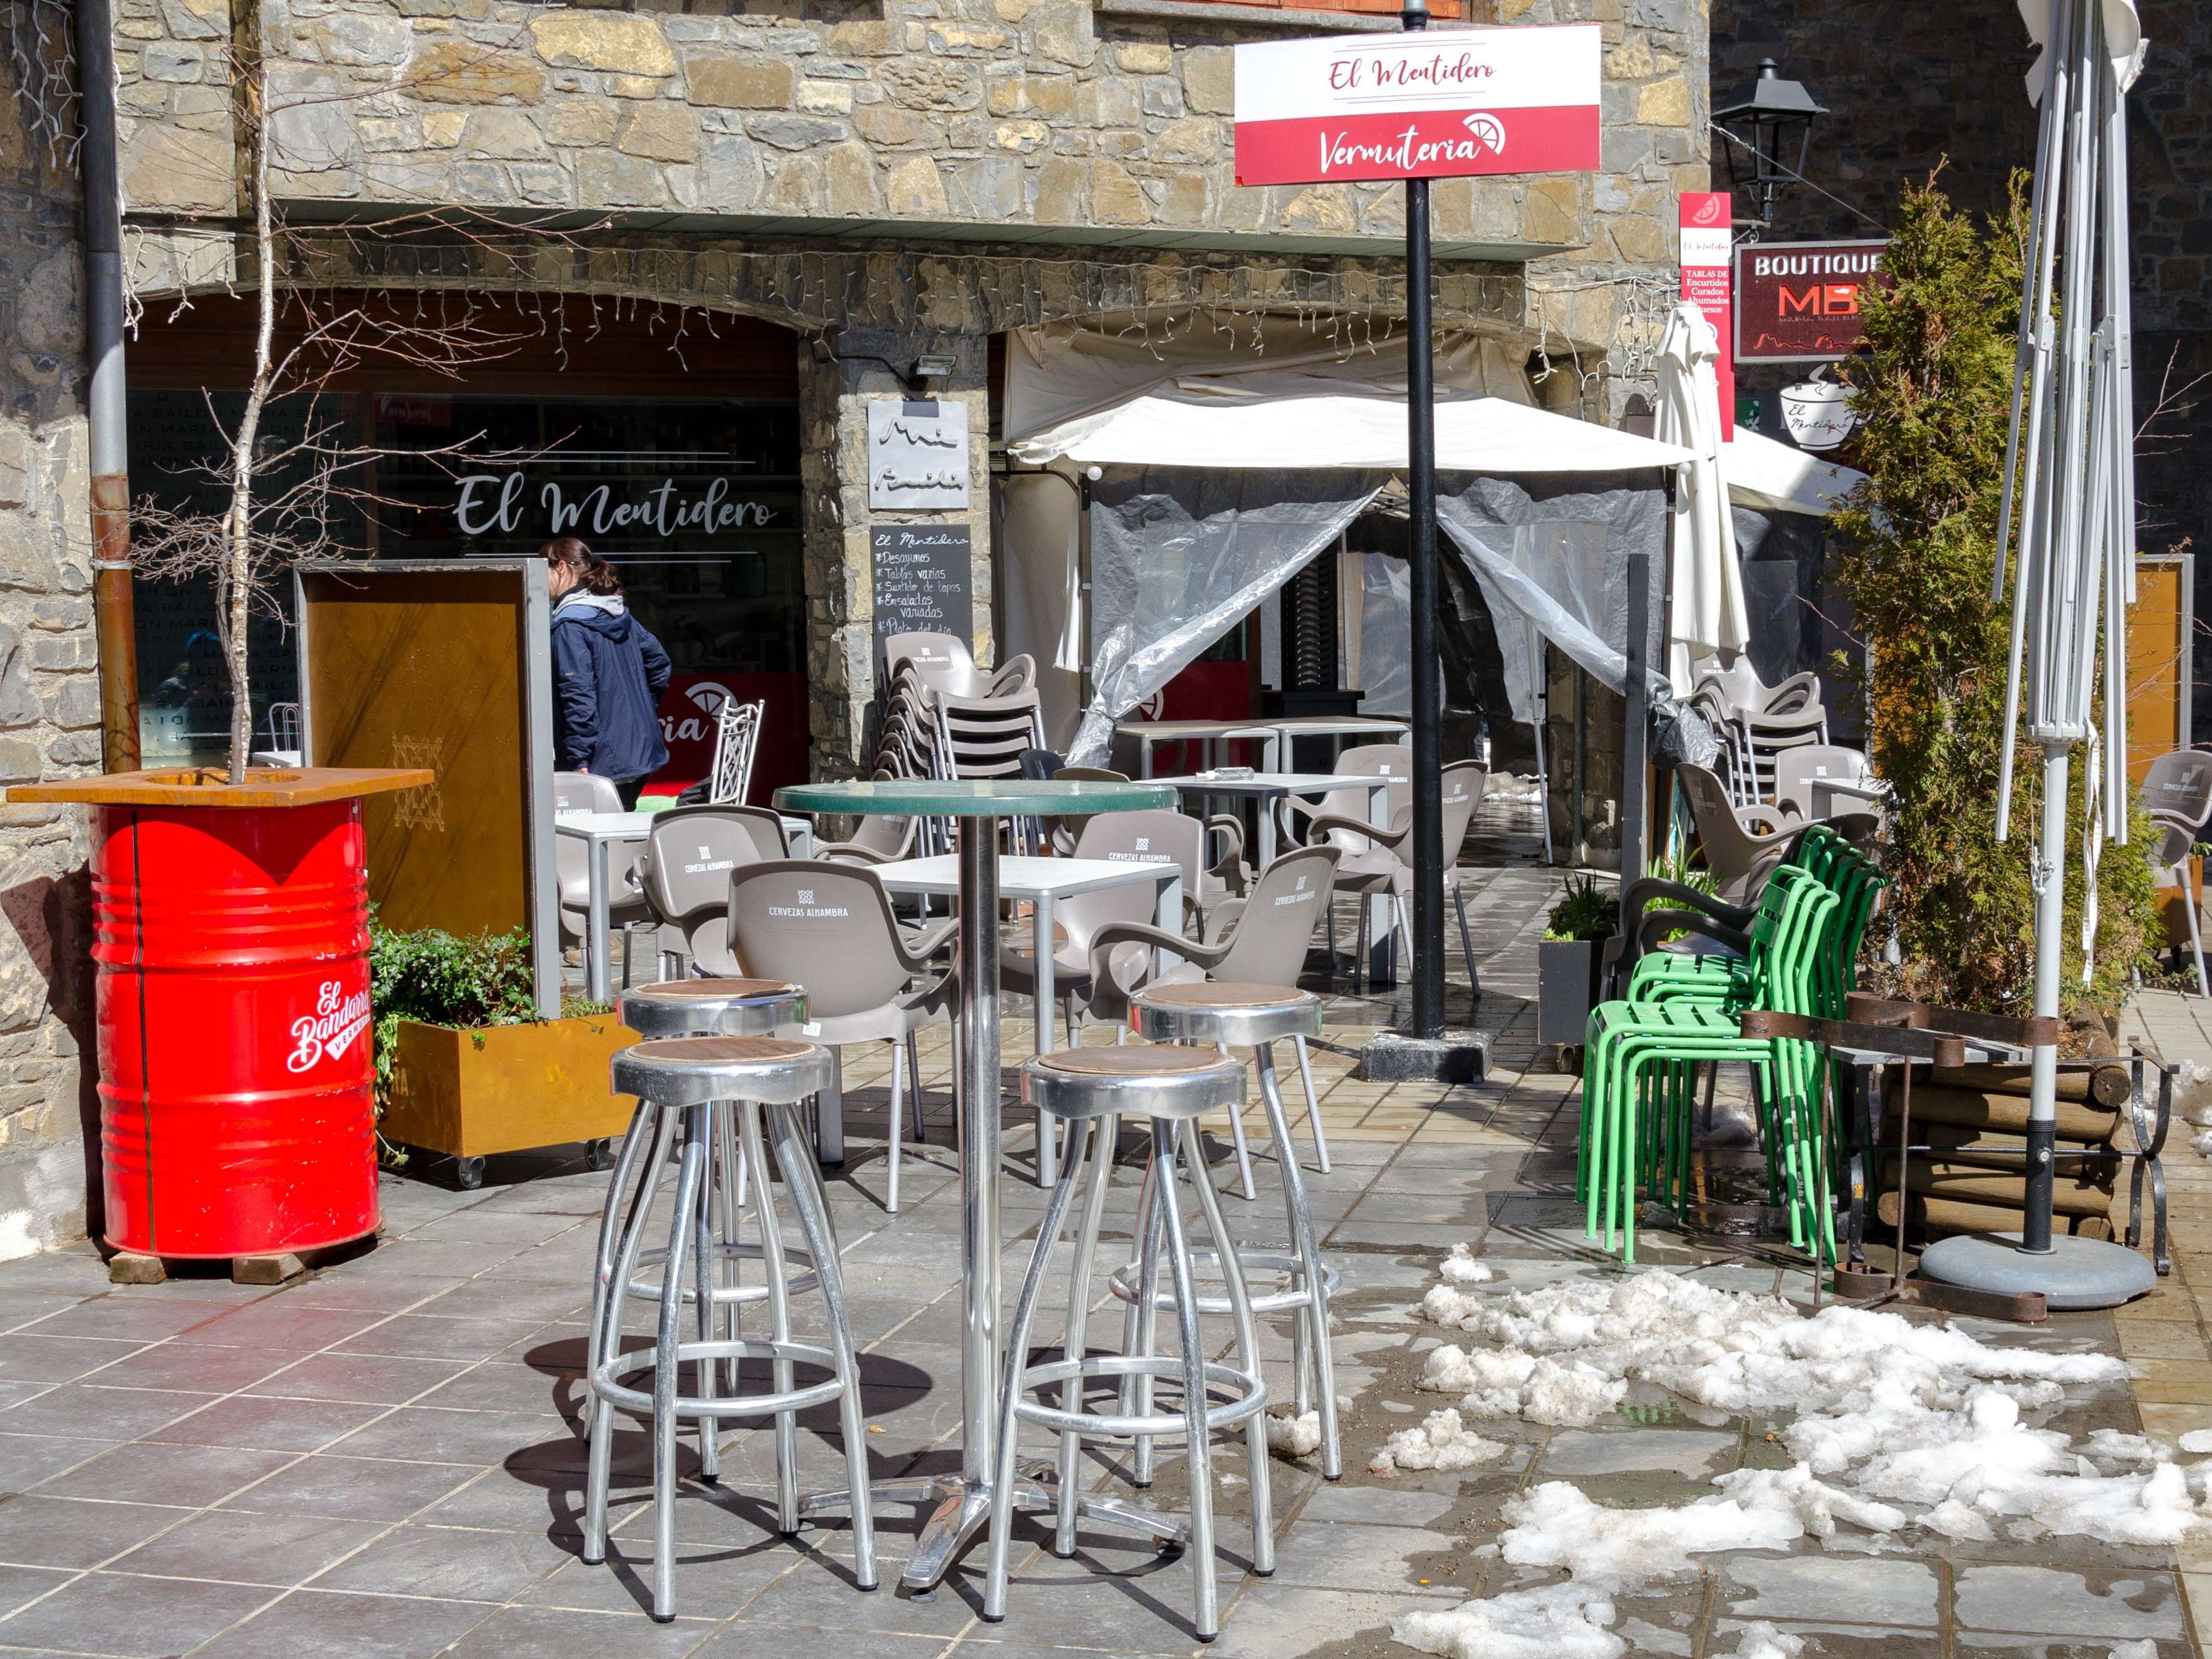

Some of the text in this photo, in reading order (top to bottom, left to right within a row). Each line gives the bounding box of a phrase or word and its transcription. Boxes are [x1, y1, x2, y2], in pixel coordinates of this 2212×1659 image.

[1329, 53, 1498, 90] El Mentidero
[1320, 125, 1482, 174] Vermuteria
[1686, 278, 1729, 286] Encurtidos
[1691, 288, 1724, 296] Curados
[1688, 296, 1730, 304] Ahumados
[1778, 283, 1859, 316] MB
[1789, 404, 1806, 415] El
[1790, 418, 1850, 431] Mentidro
[452, 472, 778, 536] El Mentidero
[875, 533, 968, 548] El Mentidero
[882, 551, 930, 568] Desayunos
[884, 567, 947, 580] Tablas varias
[885, 580, 918, 592] Surtido
[924, 581, 933, 592] de
[885, 593, 933, 606] Ensaladas
[900, 606, 943, 618] variadas
[1108, 852, 1171, 862] CERVEZAS ALHAMBRA
[769, 907, 849, 917] CERVEZAS ALHAMBRA
[317, 981, 341, 1016] El
[287, 989, 370, 1073] Bandarra
